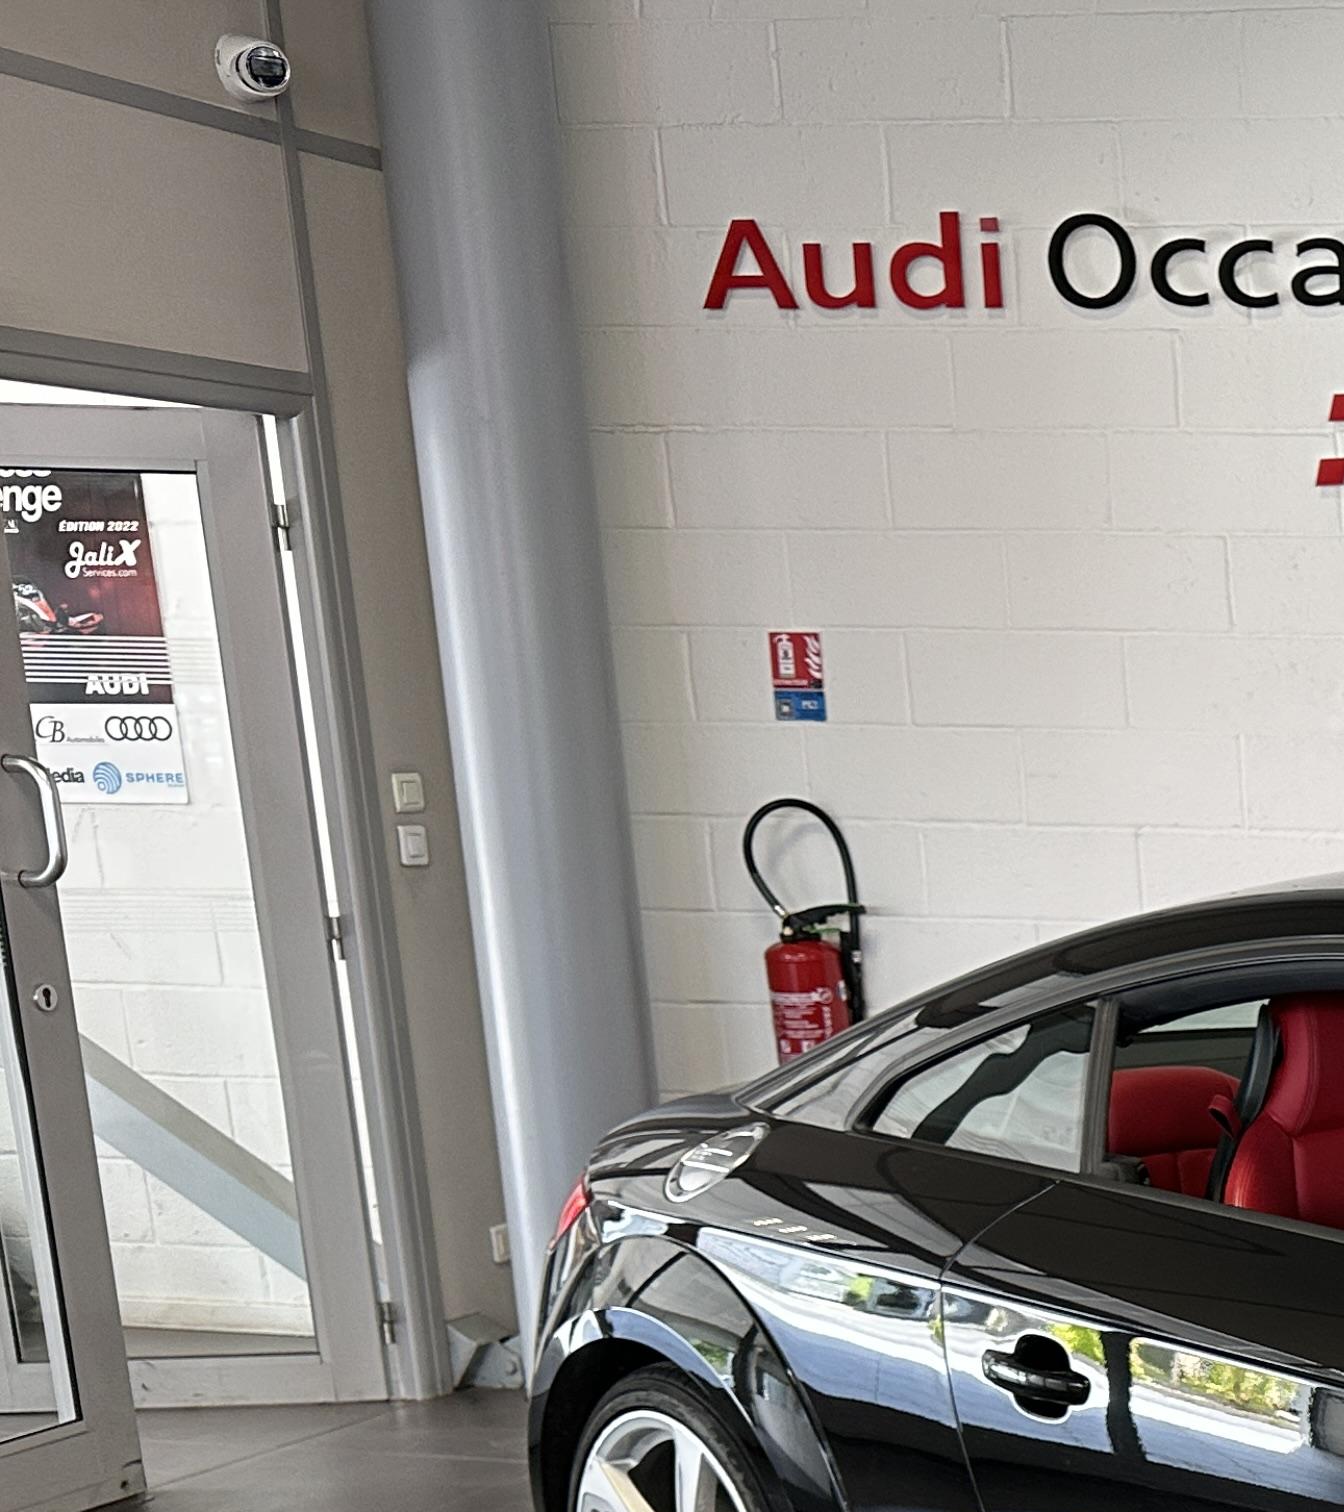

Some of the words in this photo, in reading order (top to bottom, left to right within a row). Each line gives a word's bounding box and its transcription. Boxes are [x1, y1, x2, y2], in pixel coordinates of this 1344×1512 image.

[703, 211, 1004, 310] Audi
[0, 484, 63, 522] nge
[107, 521, 139, 532] 2022
[85, 673, 150, 695] AUDI
[126, 773, 184, 784] SPHERE
